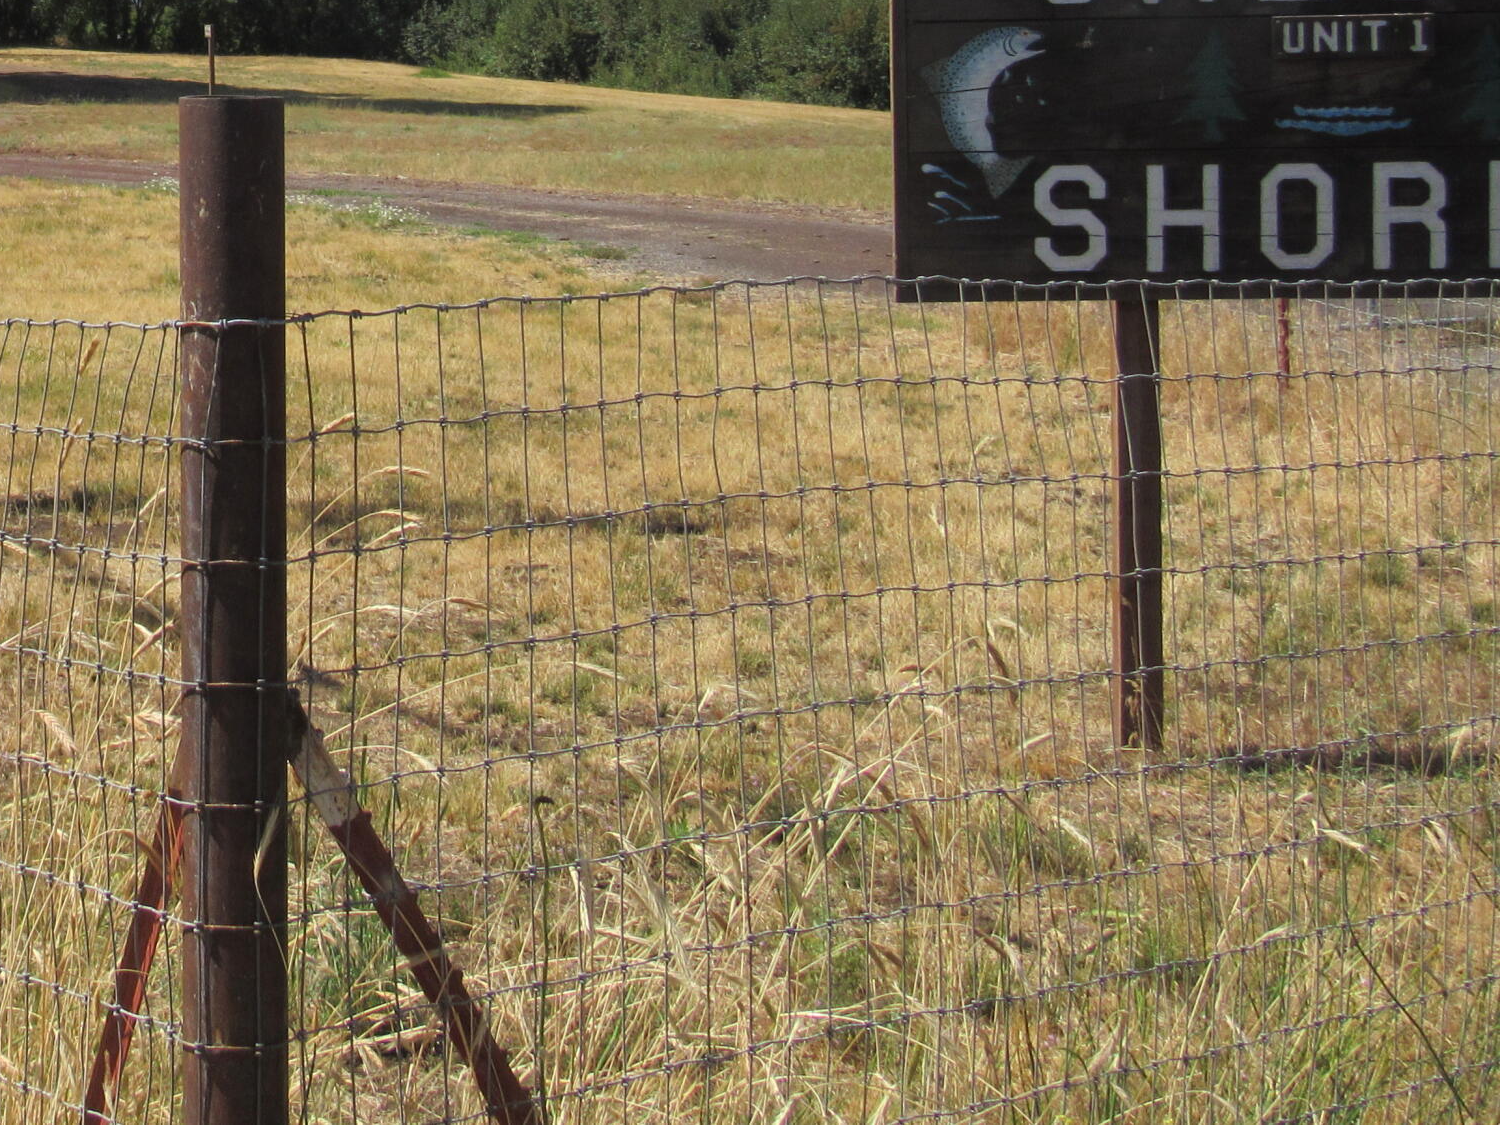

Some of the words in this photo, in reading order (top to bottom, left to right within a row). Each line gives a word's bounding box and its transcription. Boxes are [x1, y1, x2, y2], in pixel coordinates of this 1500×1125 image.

[1283, 20, 1388, 53] UNIT
[1409, 19, 1428, 52] 1
[1034, 161, 1500, 272] SHOR
